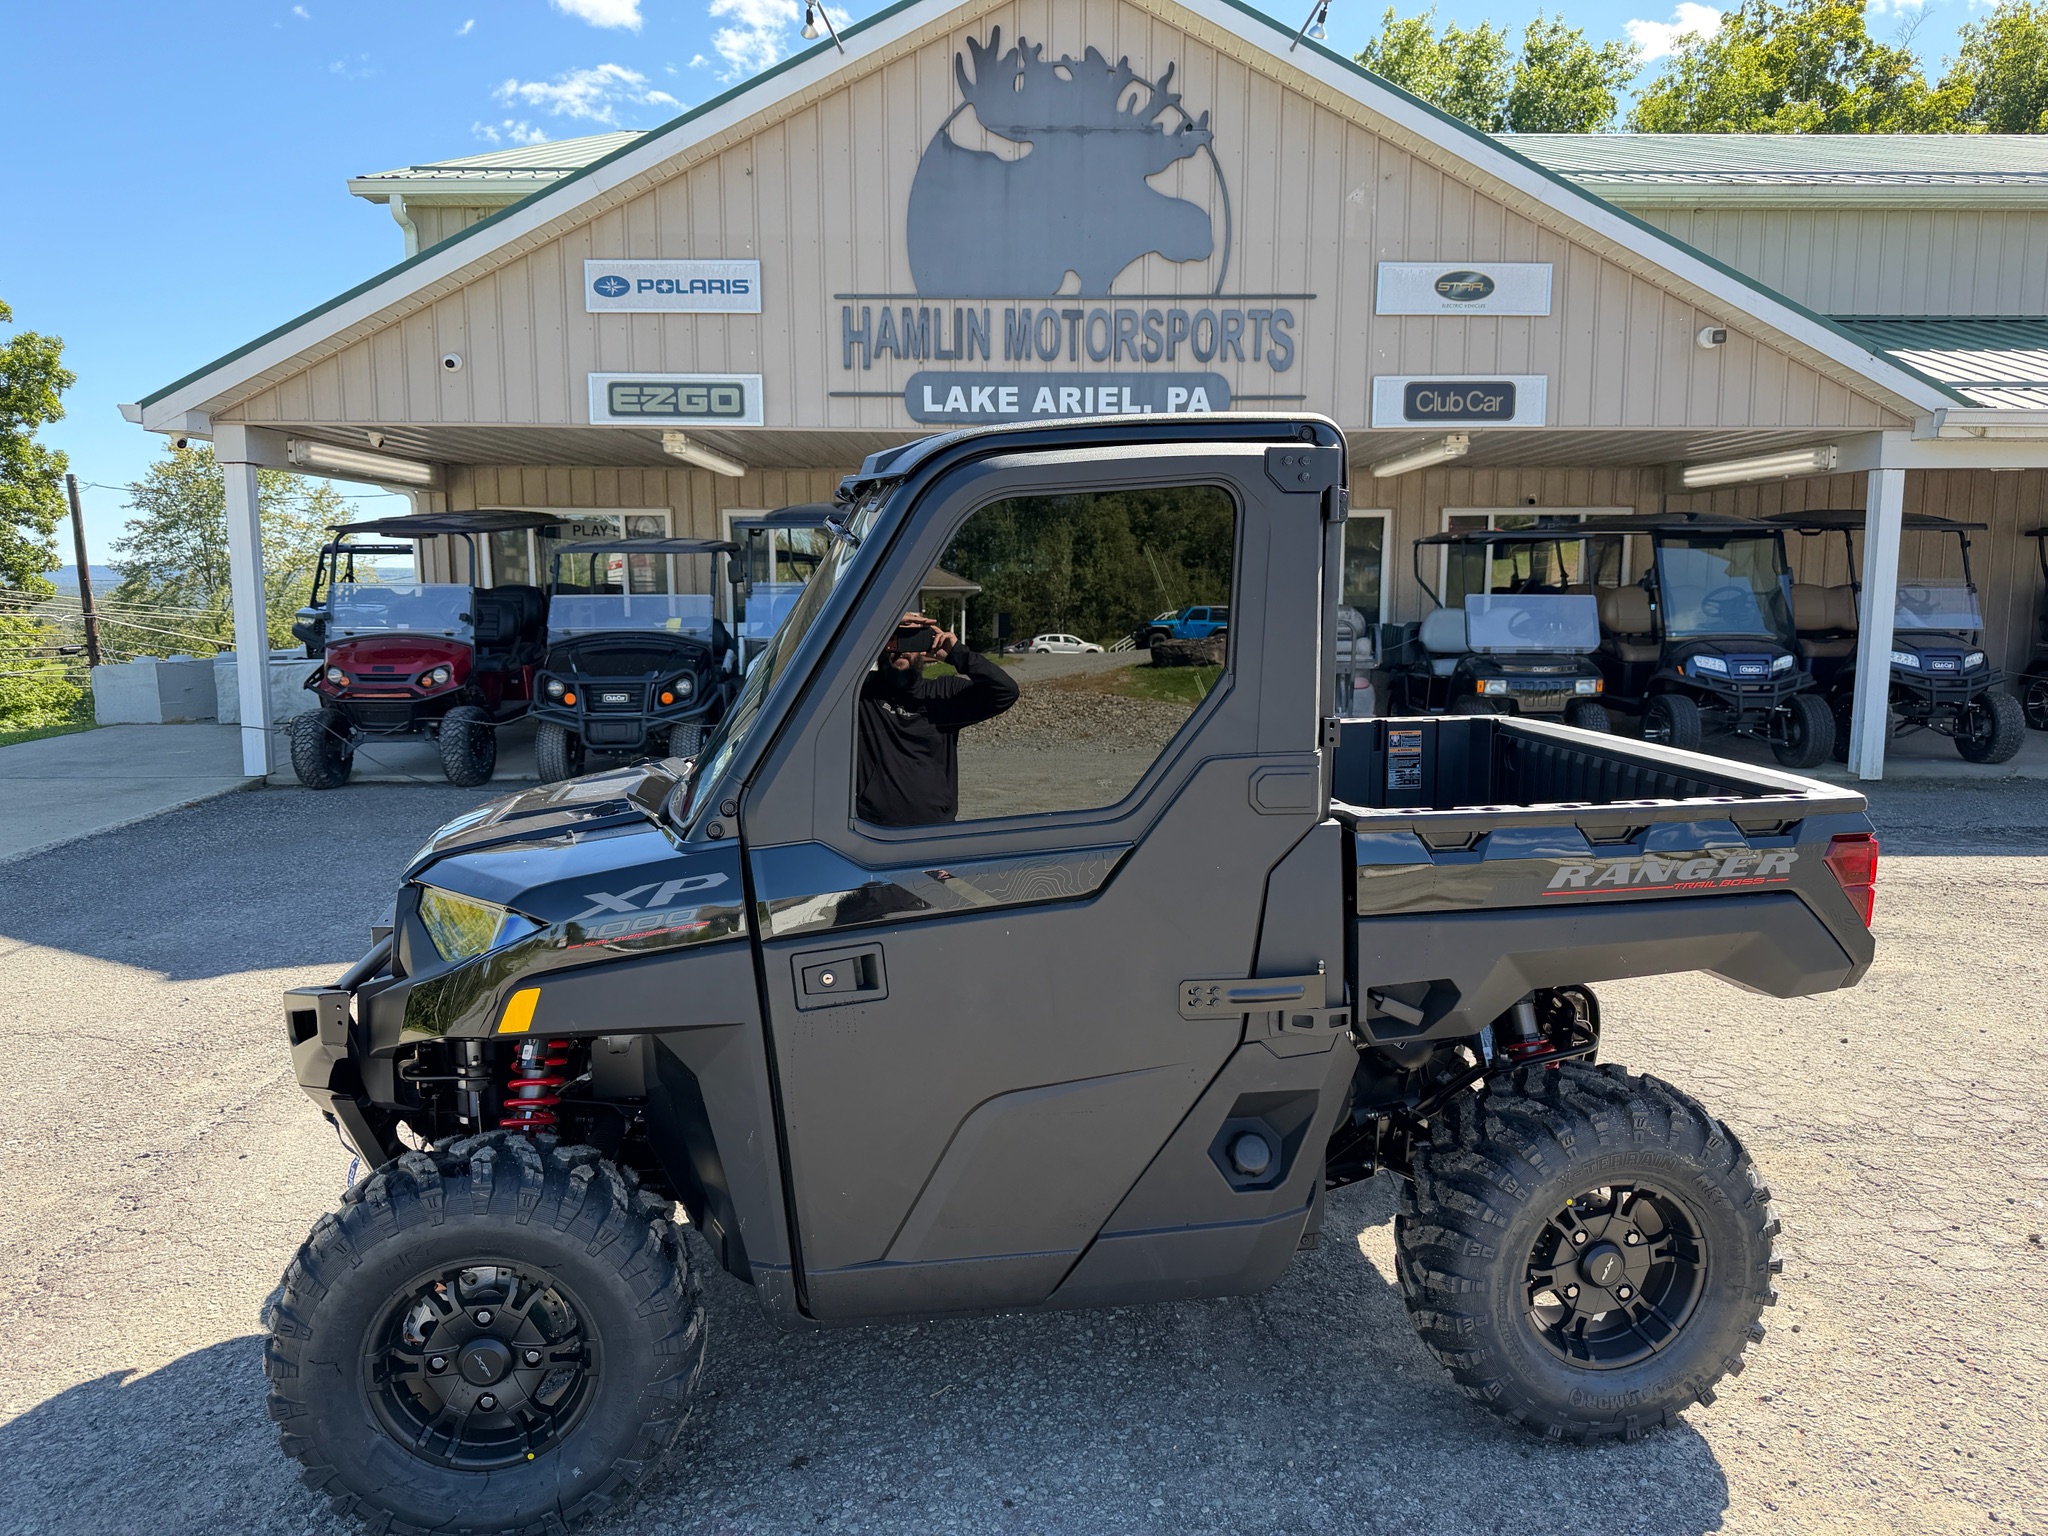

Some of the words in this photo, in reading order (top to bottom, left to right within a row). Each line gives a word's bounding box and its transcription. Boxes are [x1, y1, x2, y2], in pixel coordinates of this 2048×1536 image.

[636, 279, 750, 295] POLARIS
[1437, 281, 1484, 292] STAR
[842, 306, 990, 370] HAMLIN
[1004, 307, 1295, 373] MOTORSPORTS
[612, 386, 741, 413] EZGO
[923, 385, 1019, 413] LAKE
[1031, 386, 1152, 414] ARIEL,
[1167, 386, 1212, 412] PA
[1415, 391, 1464, 412] Club
[1466, 391, 1504, 412] Car
[572, 524, 608, 537] PLAY
[1546, 852, 1799, 889] RANGER
[1673, 880, 1718, 890] TRAIL
[1719, 877, 1766, 888] BOSS
[564, 872, 730, 922] XP
[585, 908, 698, 940] 1000
[614, 928, 669, 942] OVERHEAD
[671, 923, 694, 932] CAM
